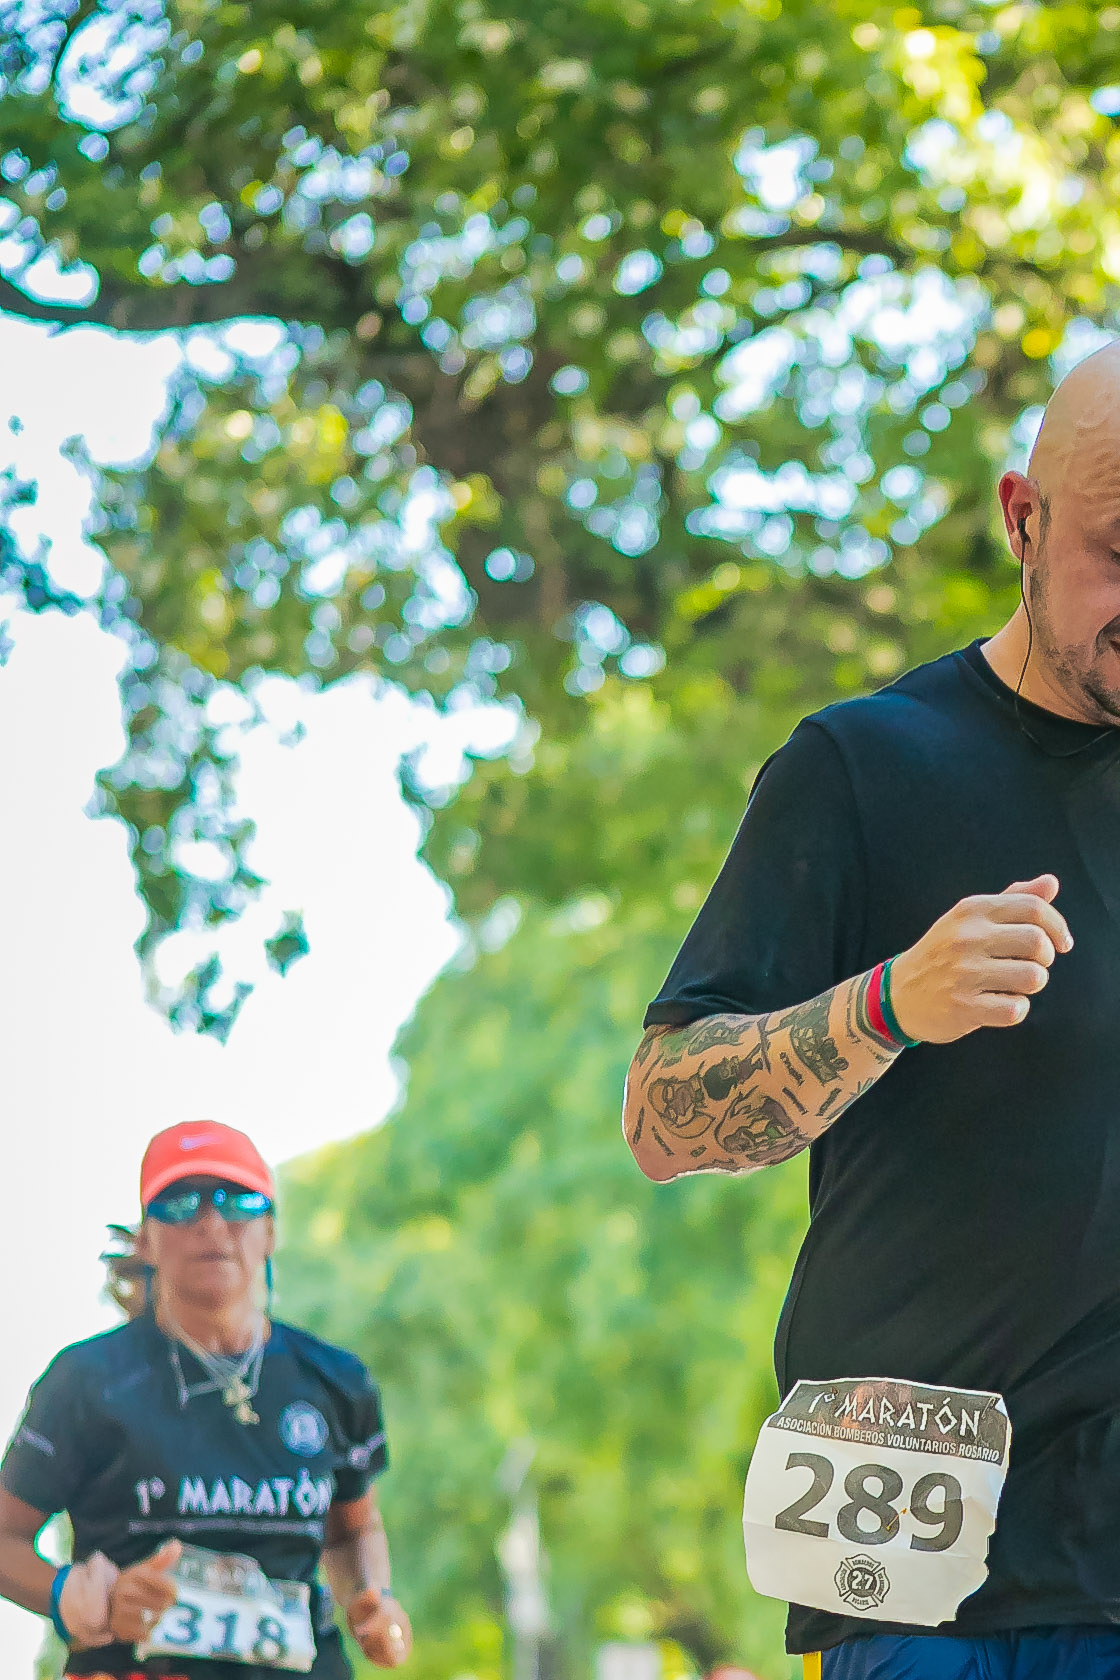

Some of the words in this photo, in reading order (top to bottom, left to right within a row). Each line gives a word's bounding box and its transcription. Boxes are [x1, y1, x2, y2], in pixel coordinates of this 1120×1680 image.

[777, 1416, 832, 1437] ASOCIACIÓN
[834, 1426, 885, 1445] BOMBEROS
[887, 1434, 956, 1455] VOLUNTARIOS
[958, 1443, 1000, 1462] ROSARIO
[834, 1393, 980, 1438] MARATÓN
[179, 1466, 334, 1517] MARATÓN
[775, 1453, 963, 1552] 289
[851, 1570, 874, 1590] 27
[164, 1601, 287, 1665] 318
